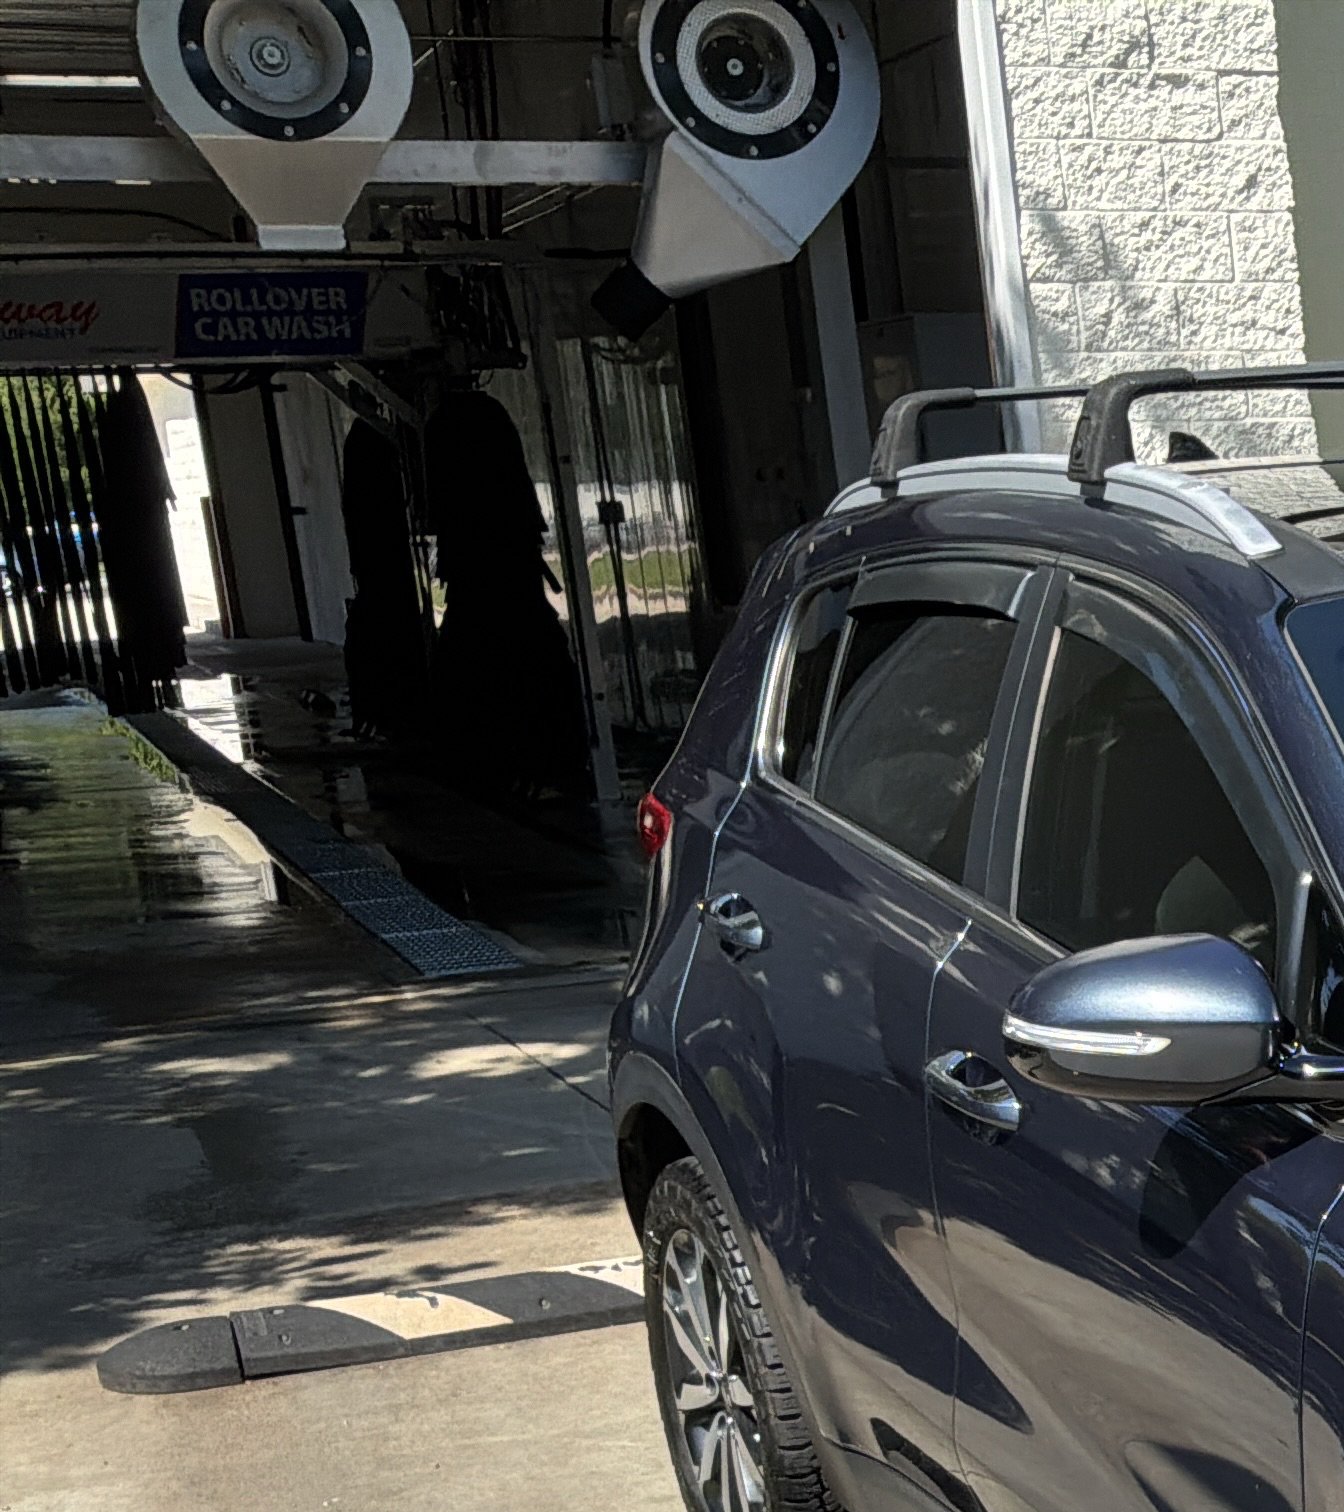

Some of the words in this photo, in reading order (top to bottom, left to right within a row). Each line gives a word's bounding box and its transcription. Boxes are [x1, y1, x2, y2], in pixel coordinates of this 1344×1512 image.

[190, 286, 347, 311] ROLLOVER
[194, 318, 257, 342] CAR
[262, 316, 353, 341] WASH
